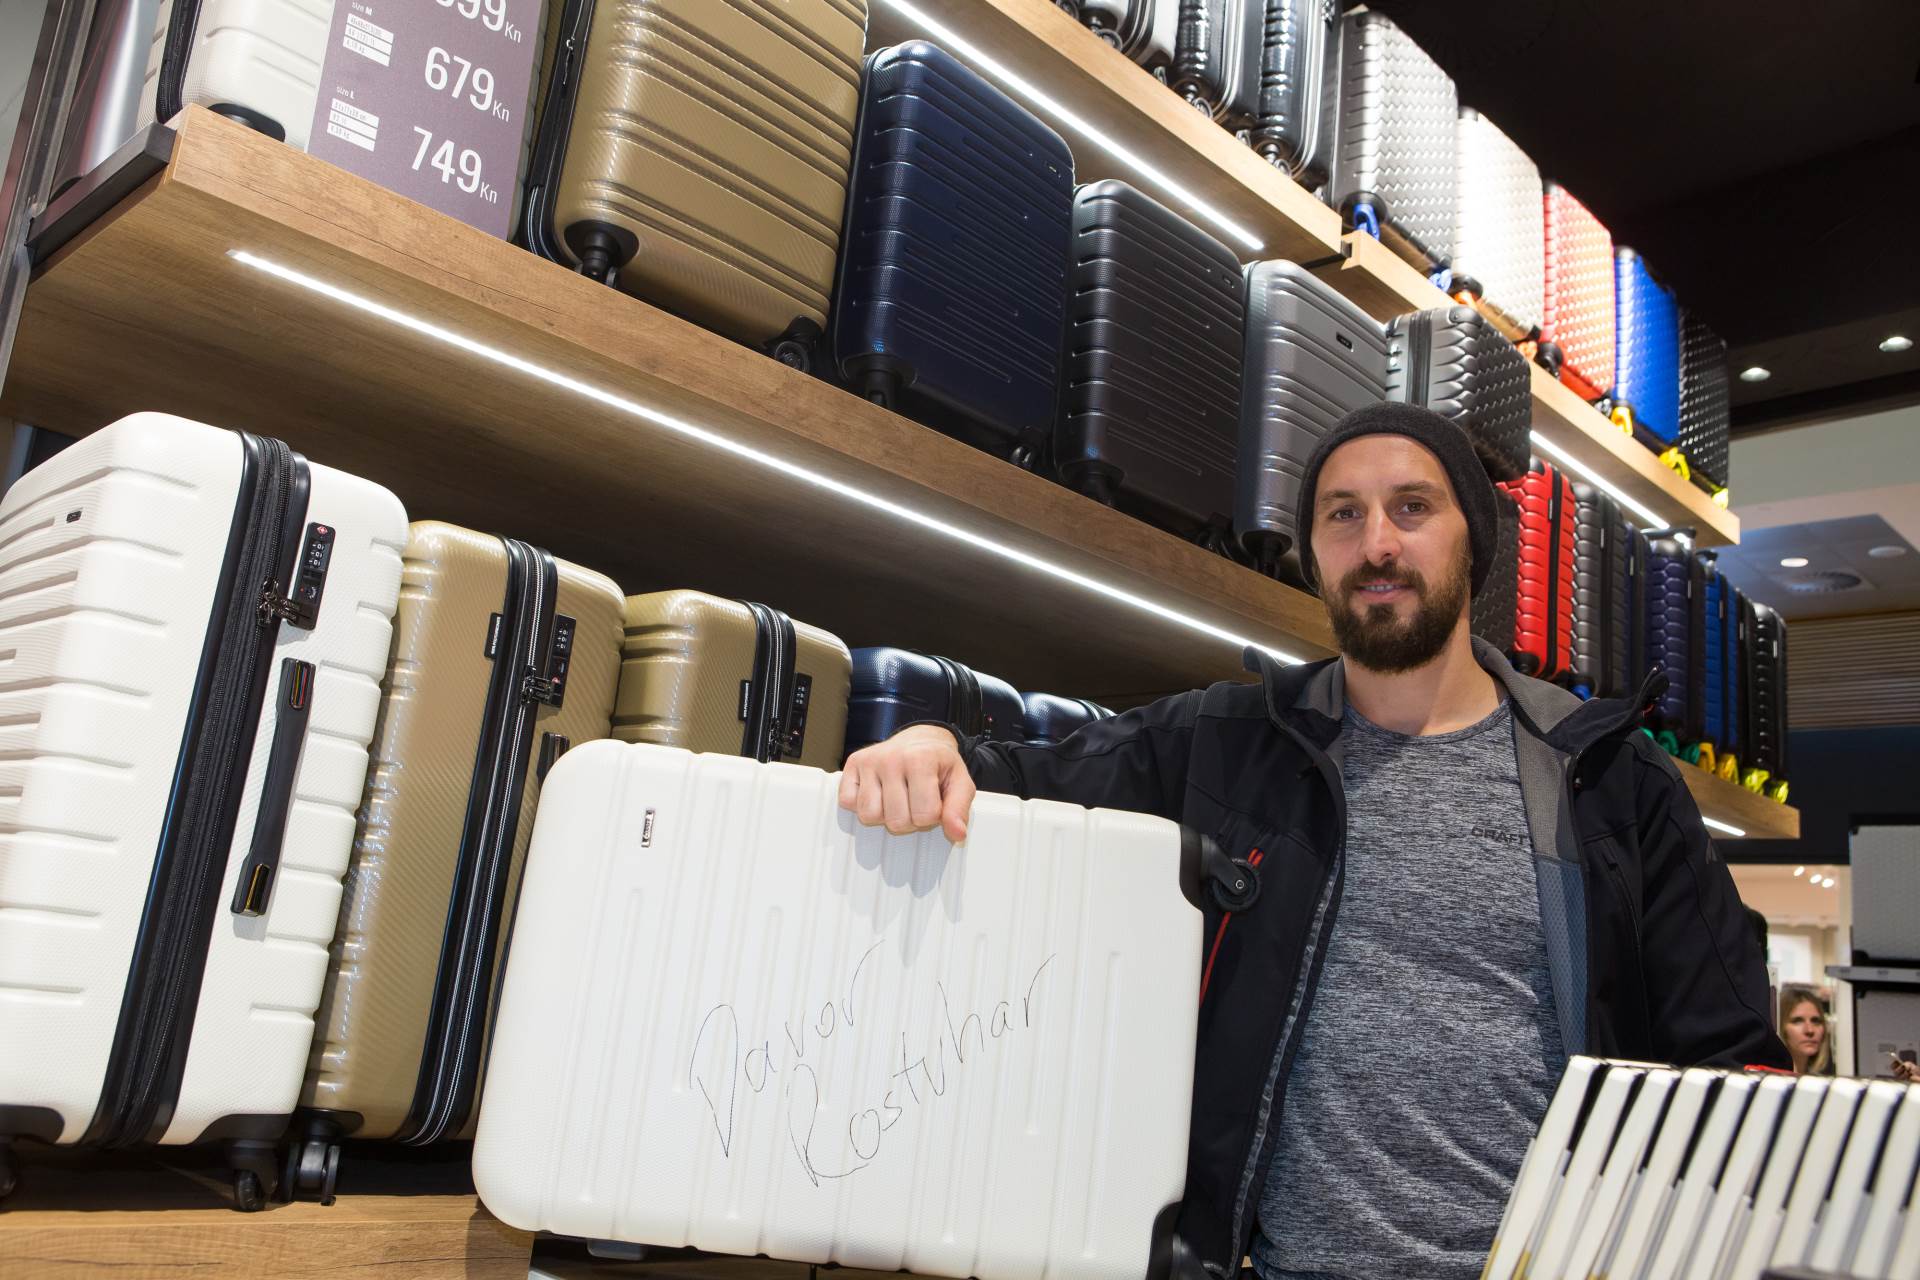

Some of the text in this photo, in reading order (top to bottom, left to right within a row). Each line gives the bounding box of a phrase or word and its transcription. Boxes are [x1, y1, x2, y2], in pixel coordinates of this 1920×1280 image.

[425, 46, 495, 111] 679
[411, 125, 482, 194] 749
[1471, 826, 1529, 846] CRAFT
[689, 939, 886, 1158] Davor
